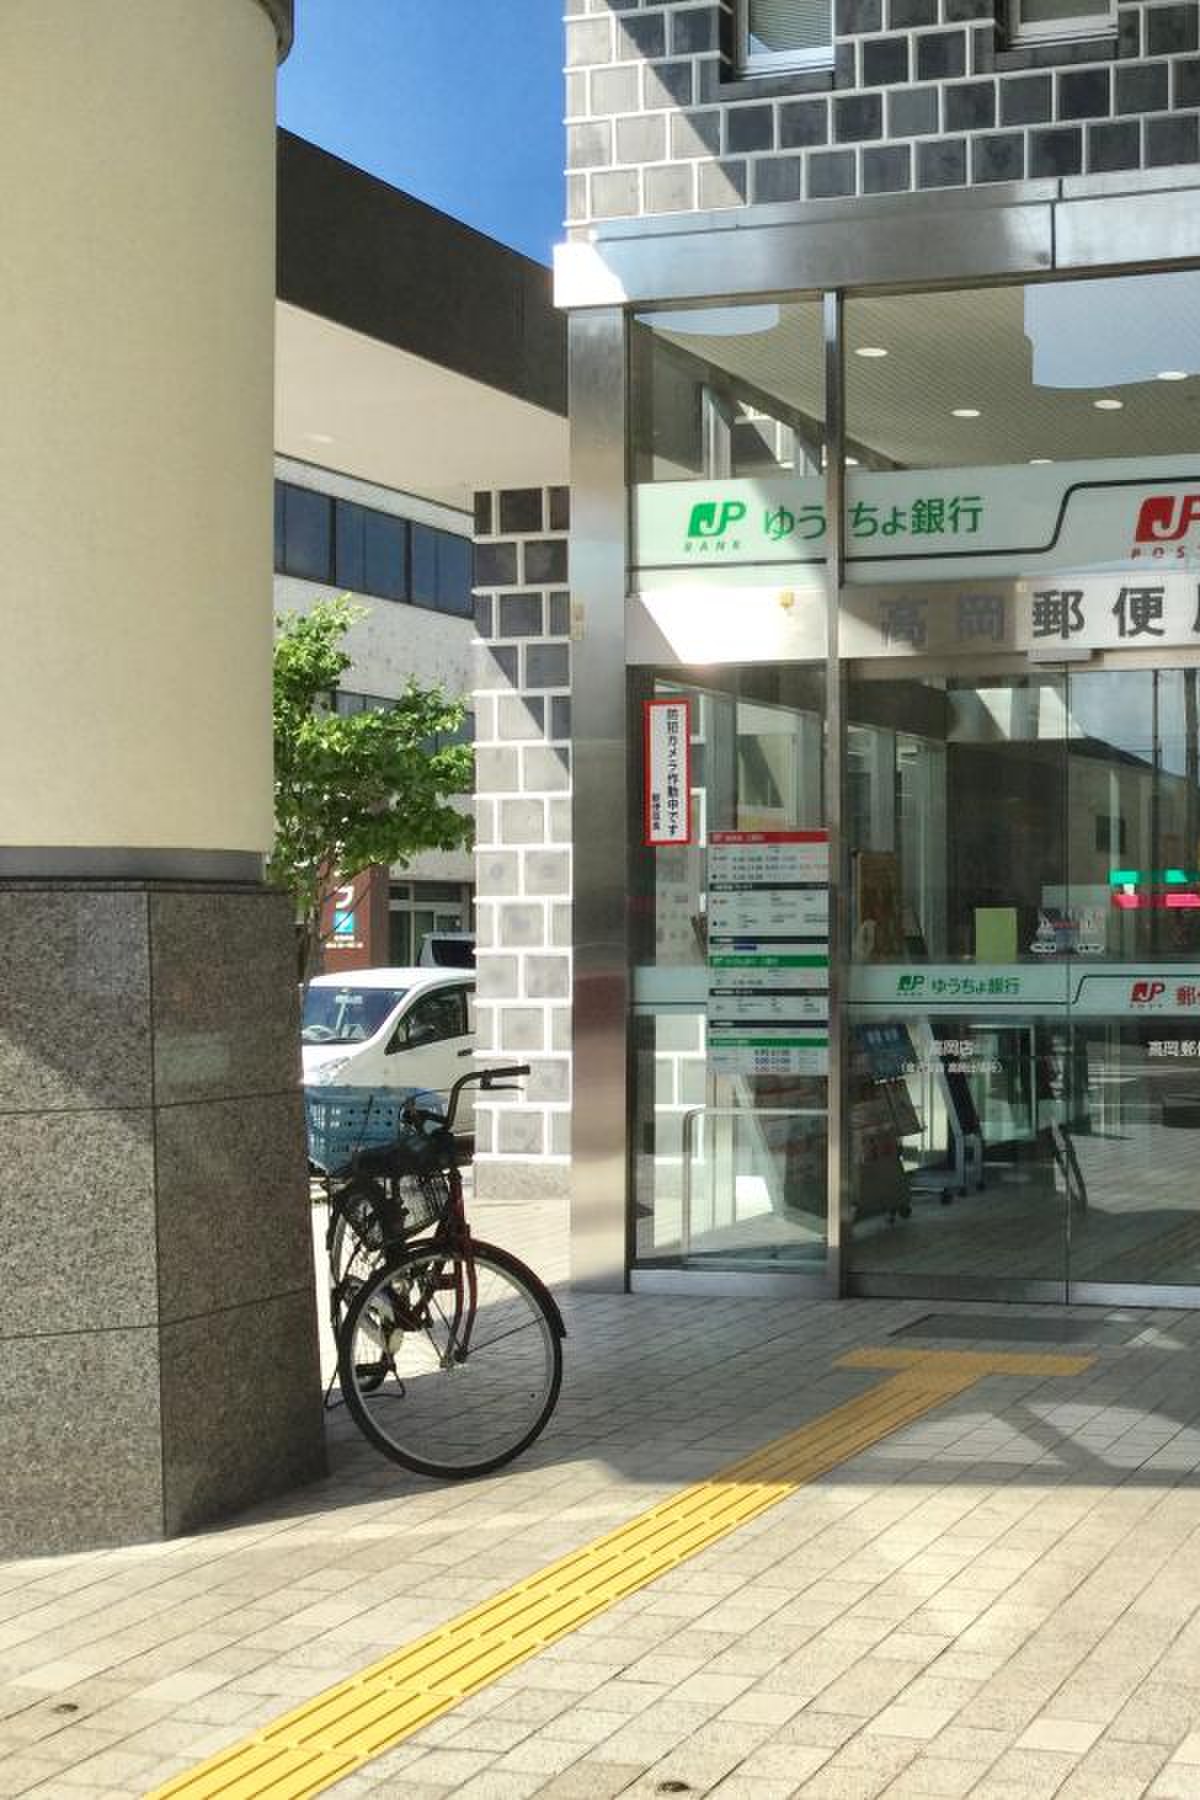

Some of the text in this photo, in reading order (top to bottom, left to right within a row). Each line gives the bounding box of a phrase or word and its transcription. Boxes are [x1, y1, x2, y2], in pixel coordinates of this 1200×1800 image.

[763, 496, 983, 541] ゆうちょ銀行
[931, 976, 1021, 994] ゆうちょ銀行
